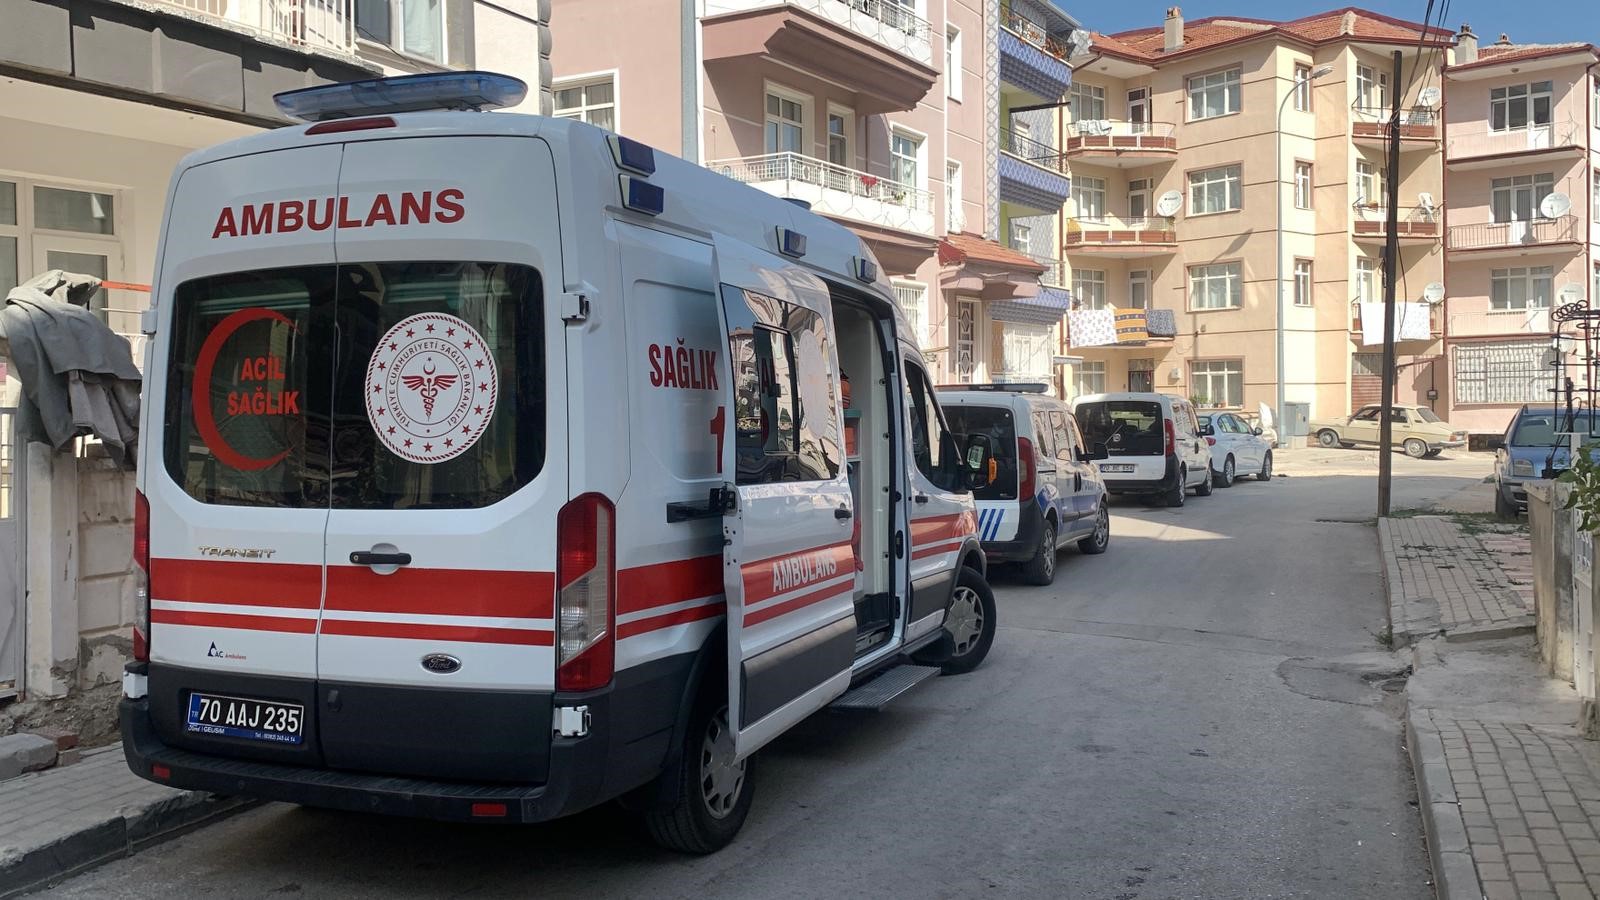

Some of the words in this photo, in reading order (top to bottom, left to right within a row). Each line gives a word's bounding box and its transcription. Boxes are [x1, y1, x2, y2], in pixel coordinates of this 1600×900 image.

[211, 188, 465, 239] AMBULANS
[241, 352, 286, 381] ACİL
[390, 340, 438, 385] CUMHURİYETİ
[441, 344, 468, 371] SAĞLIK
[649, 337, 718, 390] SAĞLIK
[227, 386, 300, 416] SAĞLIK
[446, 373, 471, 427] BAKANLIĞI
[199, 546, 277, 558] TRANSIT
[773, 547, 837, 592] AMBULANS
[199, 698, 221, 723] 70
[225, 702, 260, 728] AAJ
[263, 706, 300, 733] 235
